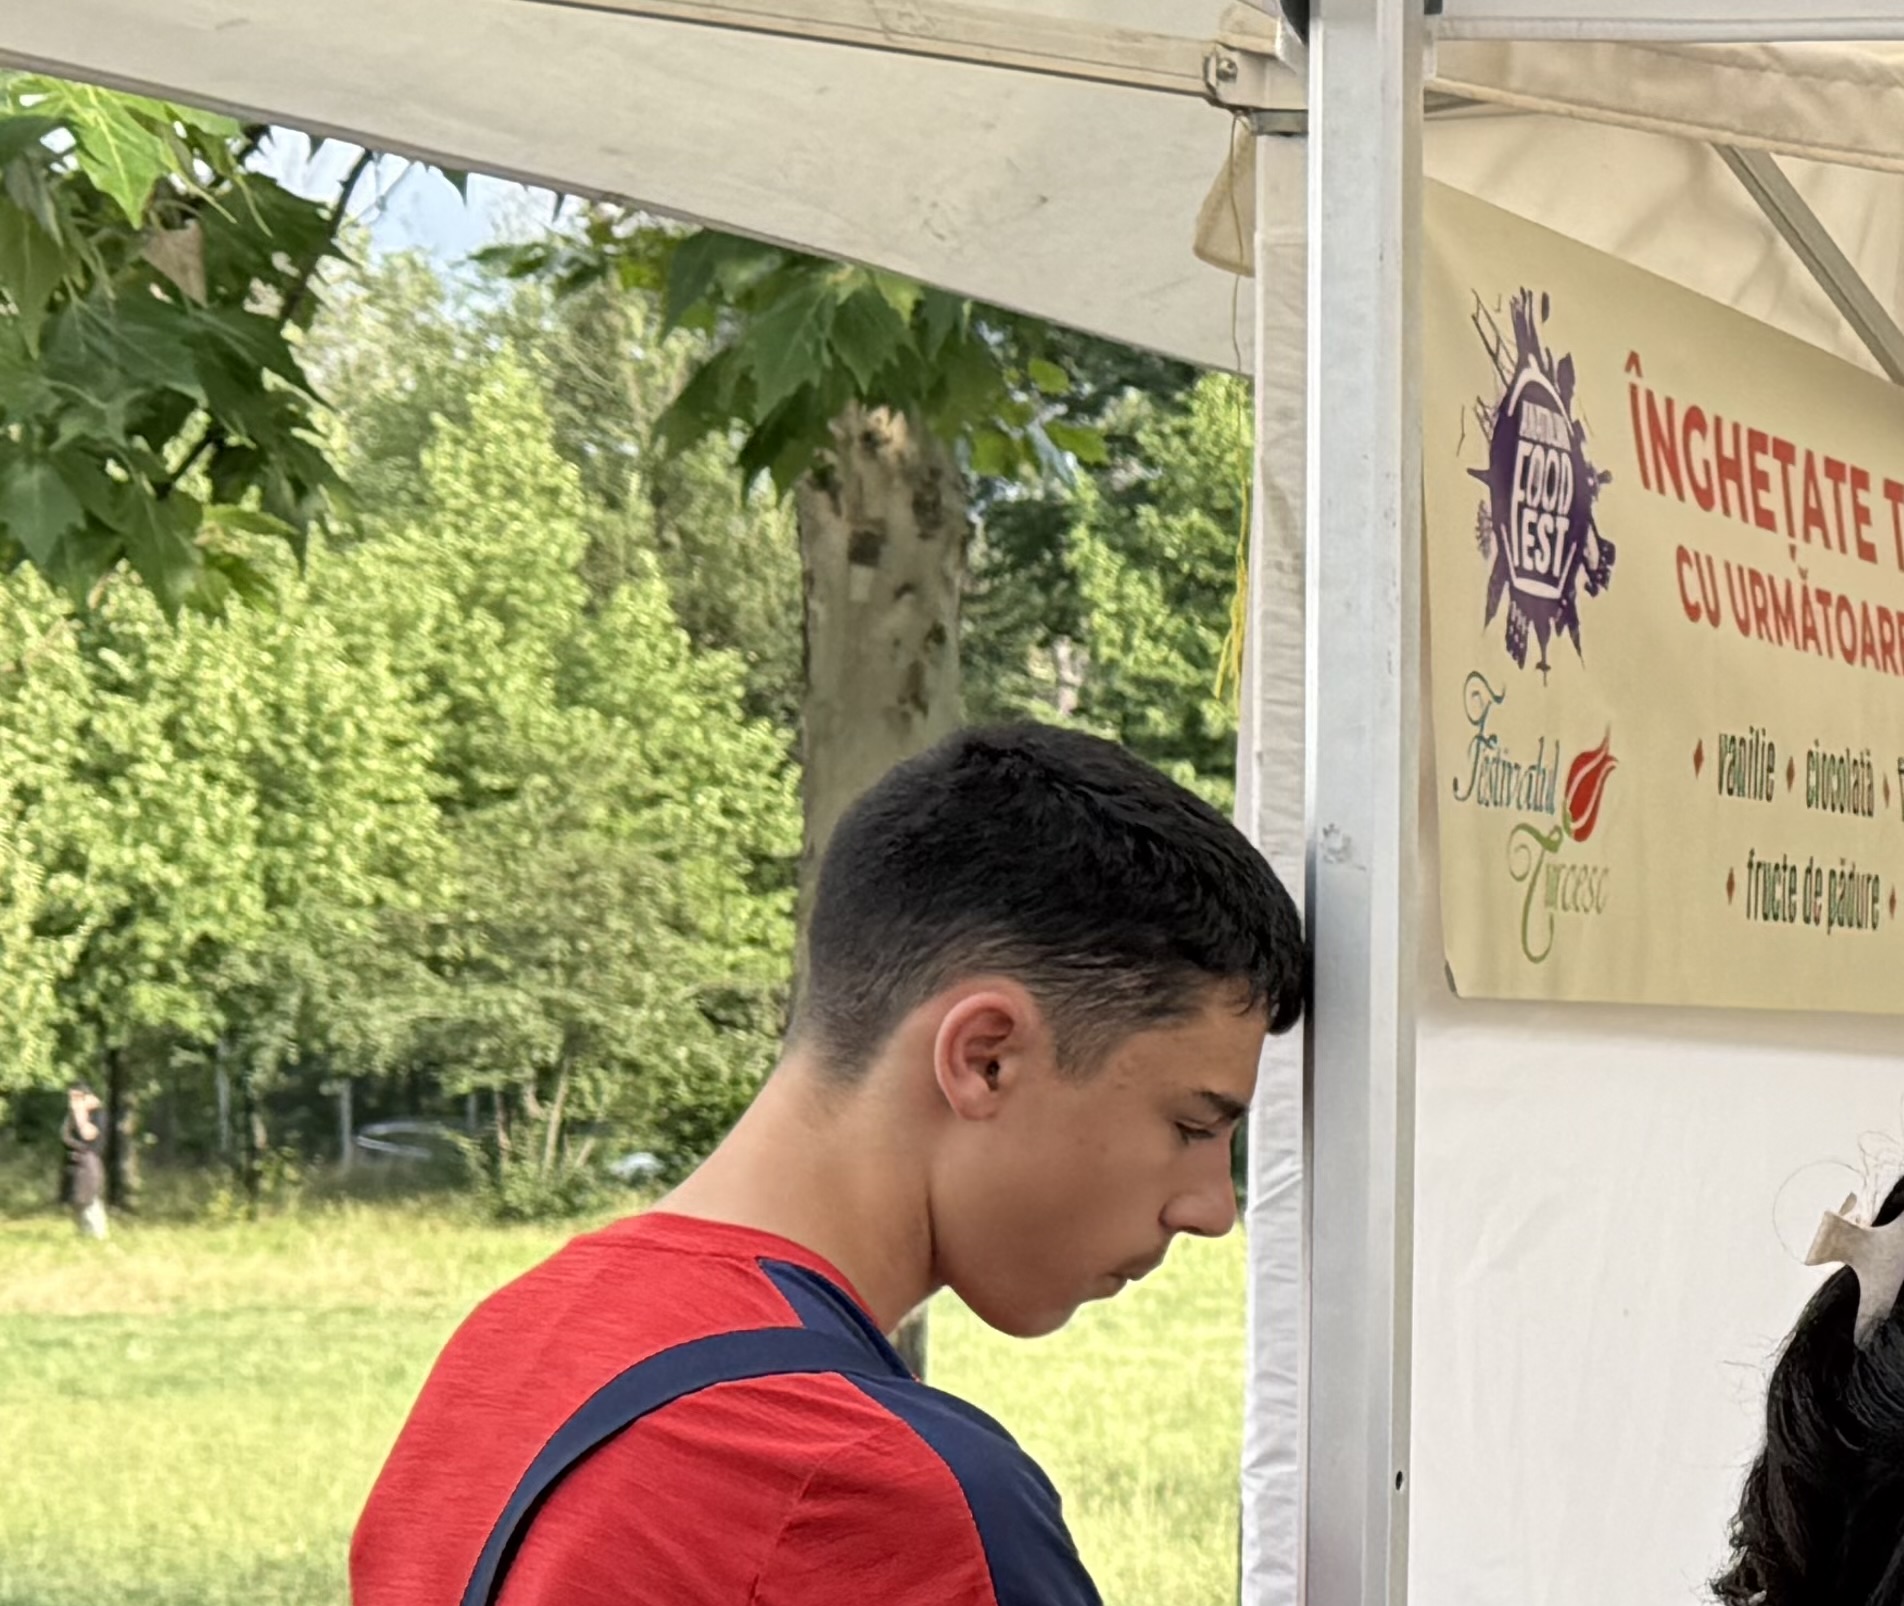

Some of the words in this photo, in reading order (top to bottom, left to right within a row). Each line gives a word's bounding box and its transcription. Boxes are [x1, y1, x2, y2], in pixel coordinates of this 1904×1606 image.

[1511, 440, 1573, 515] FOOD
[1624, 351, 1877, 564] ÎNGHEȚATE
[1676, 544, 1721, 628] CU
[1718, 726, 1776, 802] vanilie
[1746, 848, 1798, 923] fructe
[1803, 856, 1823, 926] de
